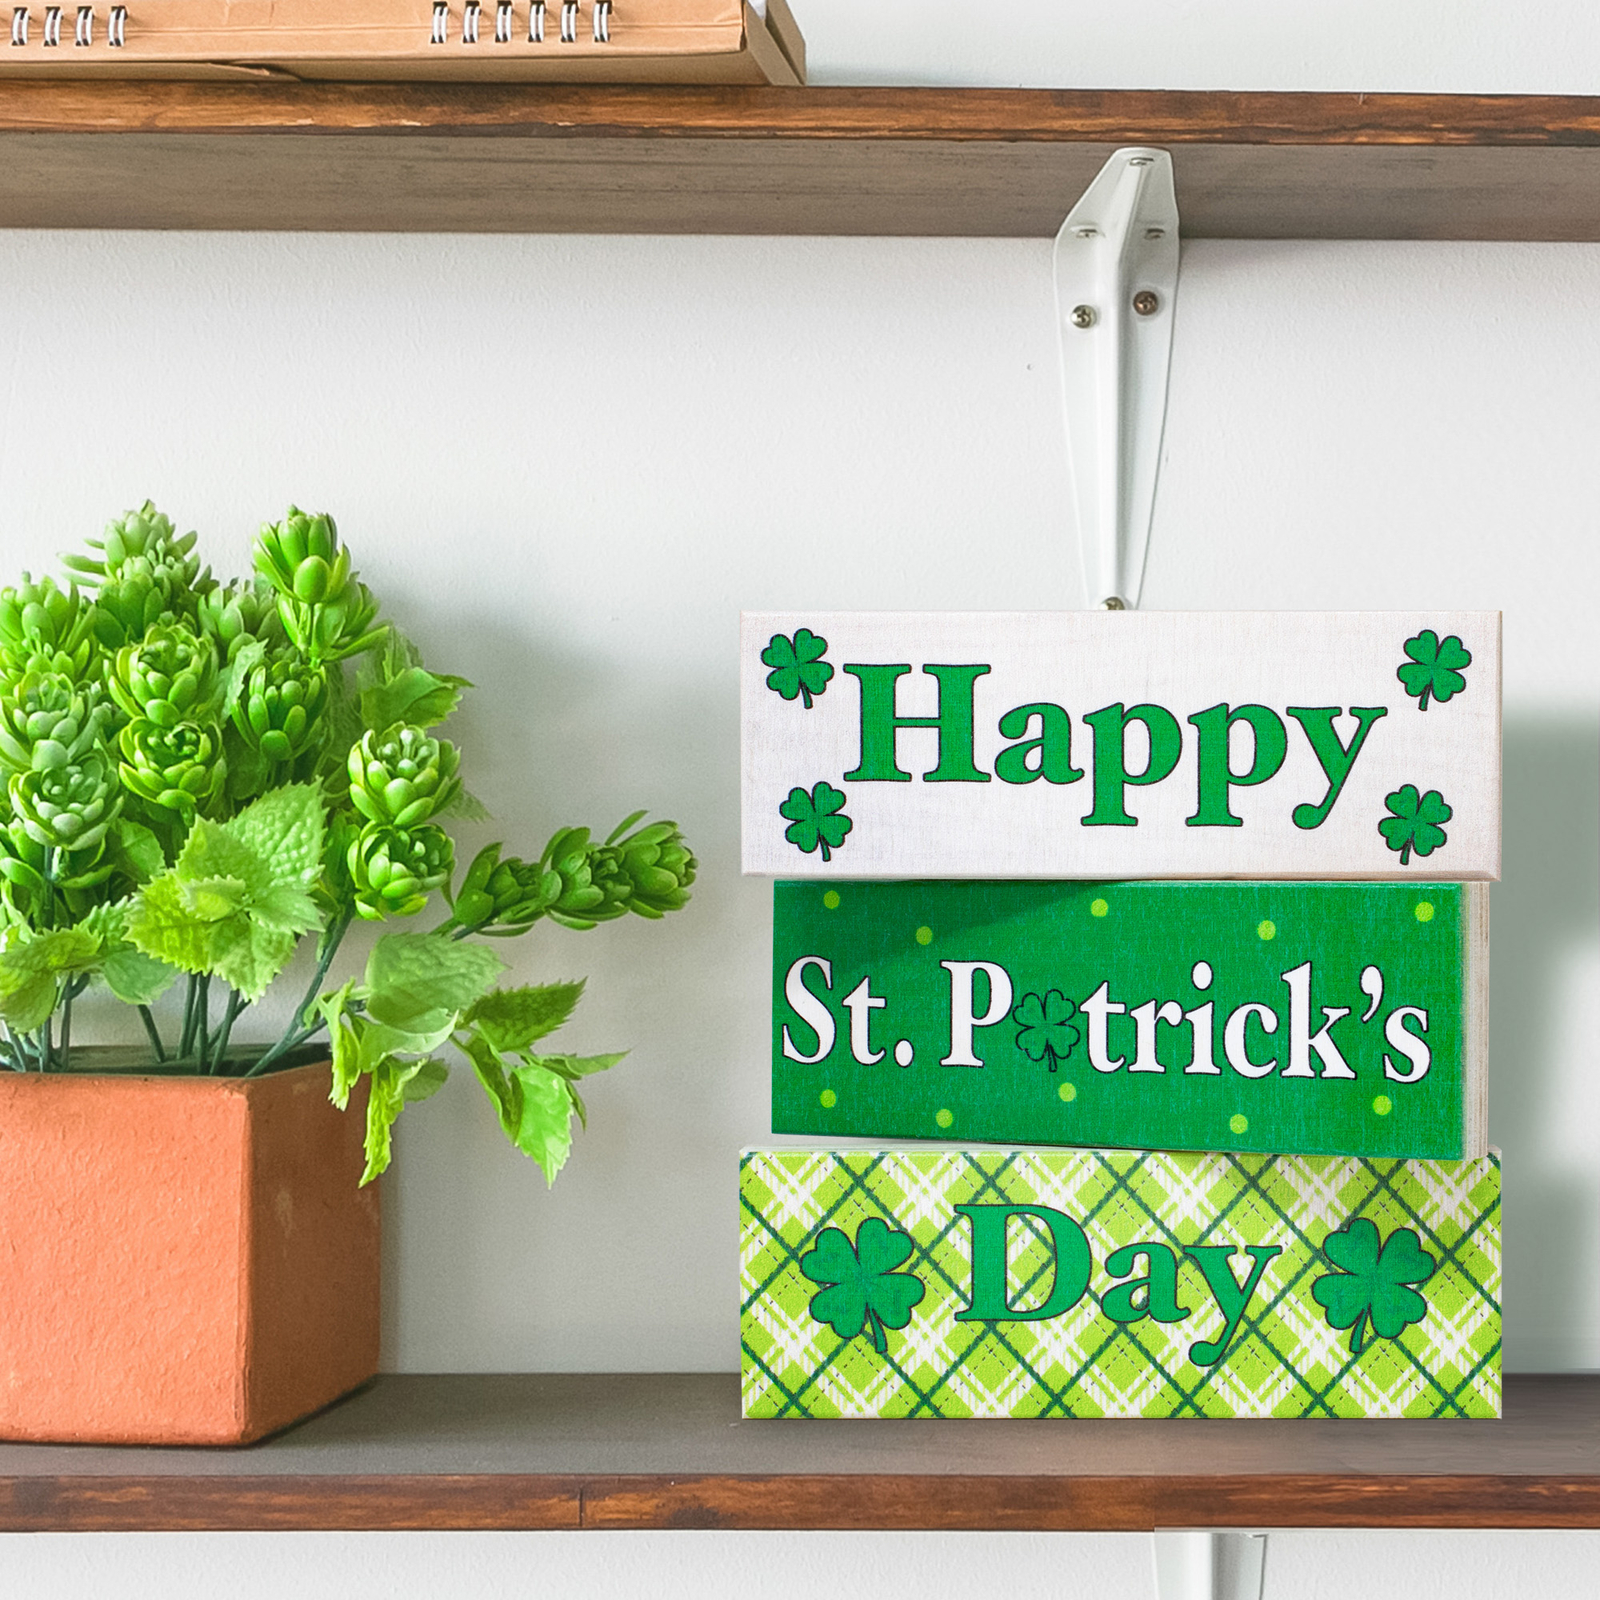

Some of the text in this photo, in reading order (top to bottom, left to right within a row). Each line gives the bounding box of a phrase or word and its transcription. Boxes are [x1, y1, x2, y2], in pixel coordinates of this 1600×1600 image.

[842, 663, 1388, 829] Happy
[781, 954, 1432, 1084] St. Ptrick's
[954, 1203, 1283, 1367] Day
